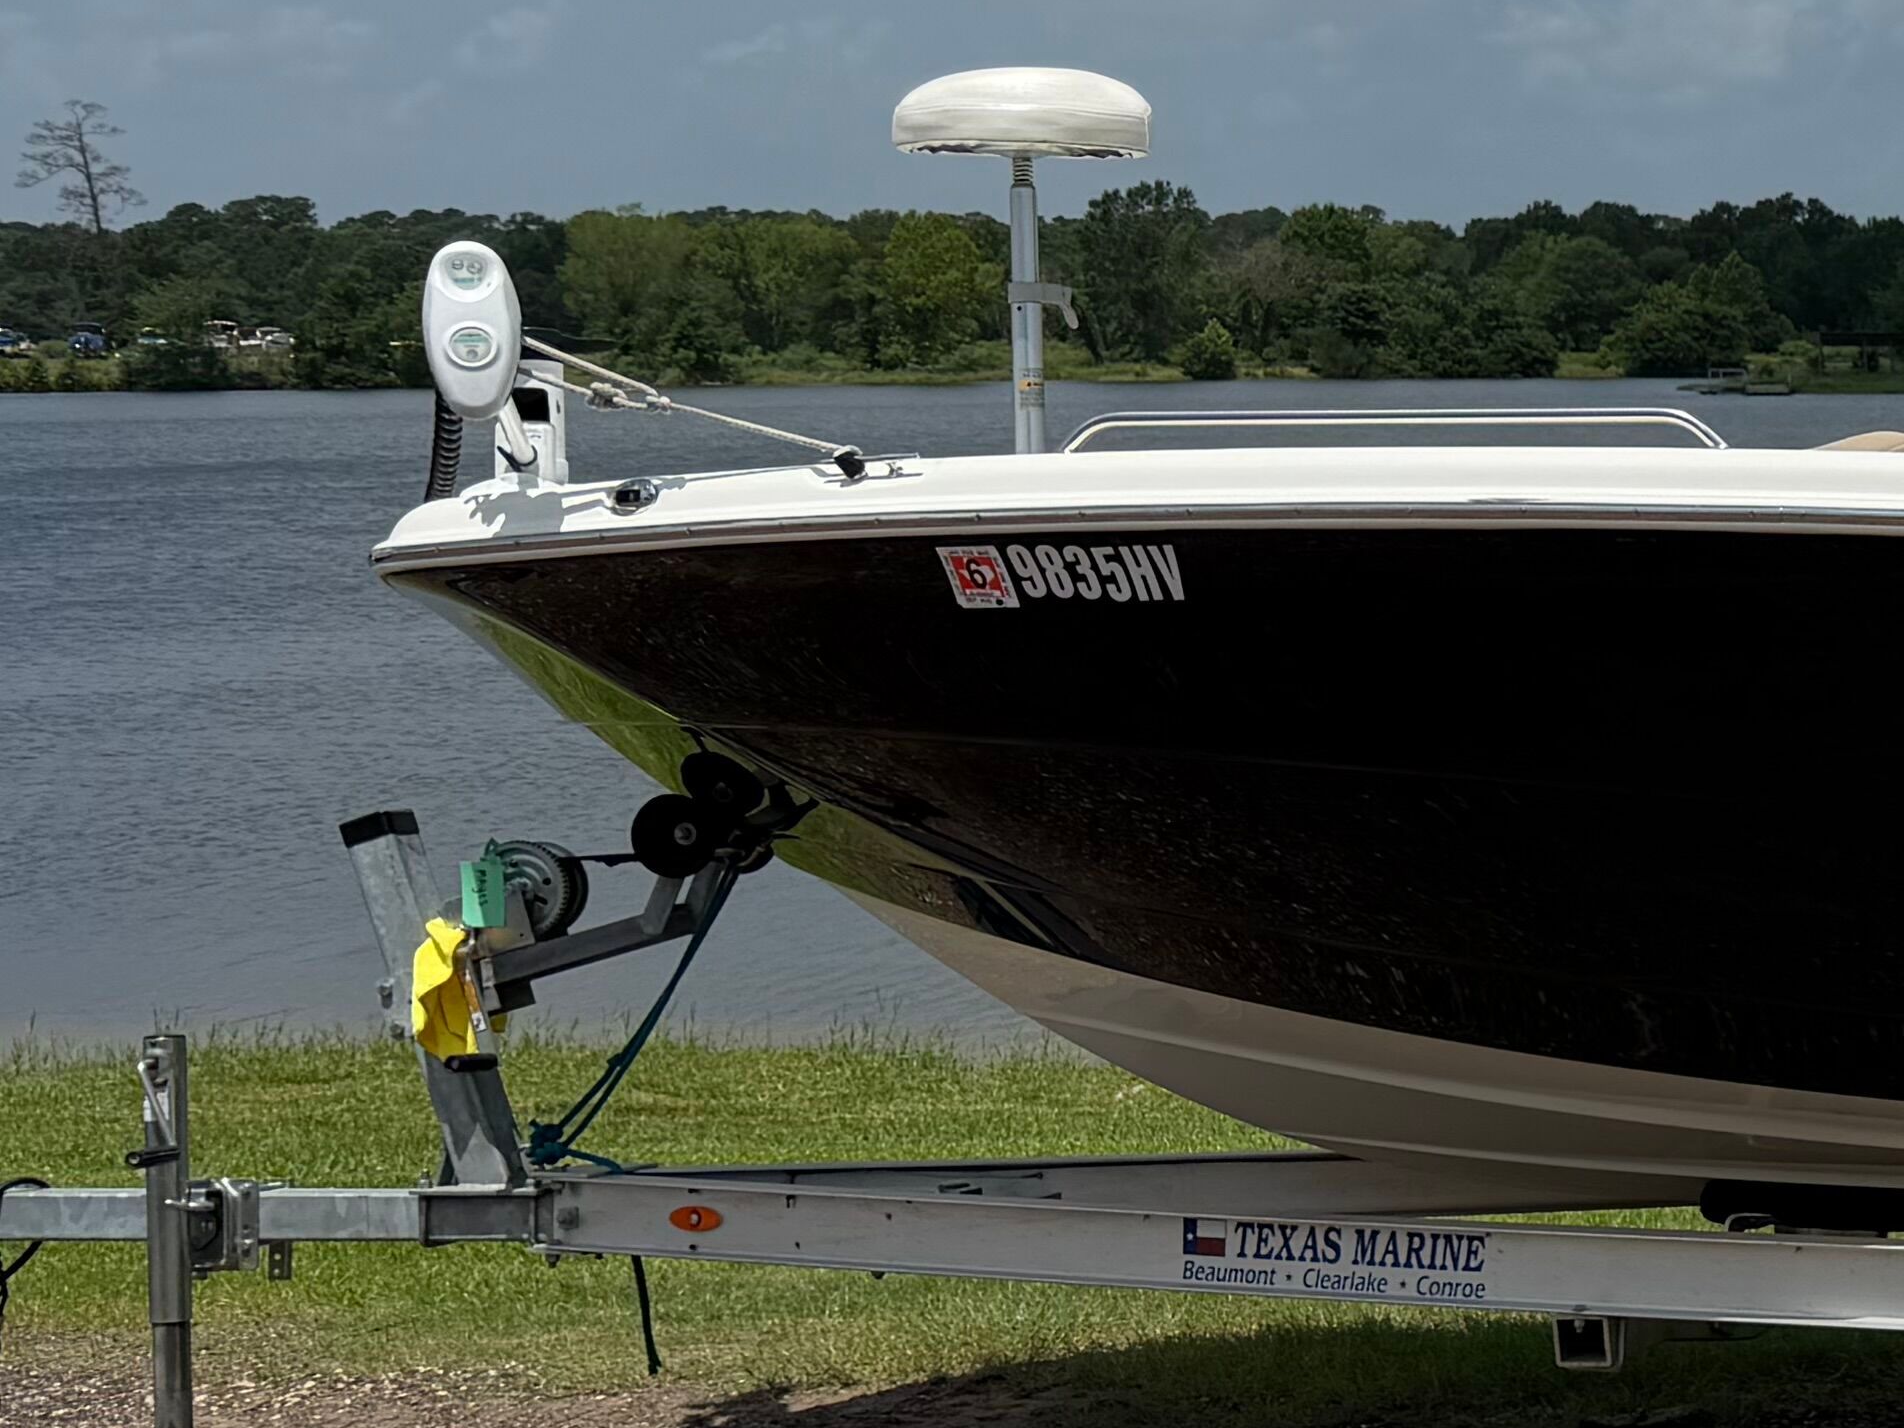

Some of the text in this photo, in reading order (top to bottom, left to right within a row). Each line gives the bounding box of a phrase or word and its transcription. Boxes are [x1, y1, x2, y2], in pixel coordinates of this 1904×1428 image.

[1005, 544, 1185, 602] 9835HV
[1234, 1221, 1487, 1272] TEXAS MARINE
[1182, 1260, 1487, 1299] Beaumont Clearlake Conroe
